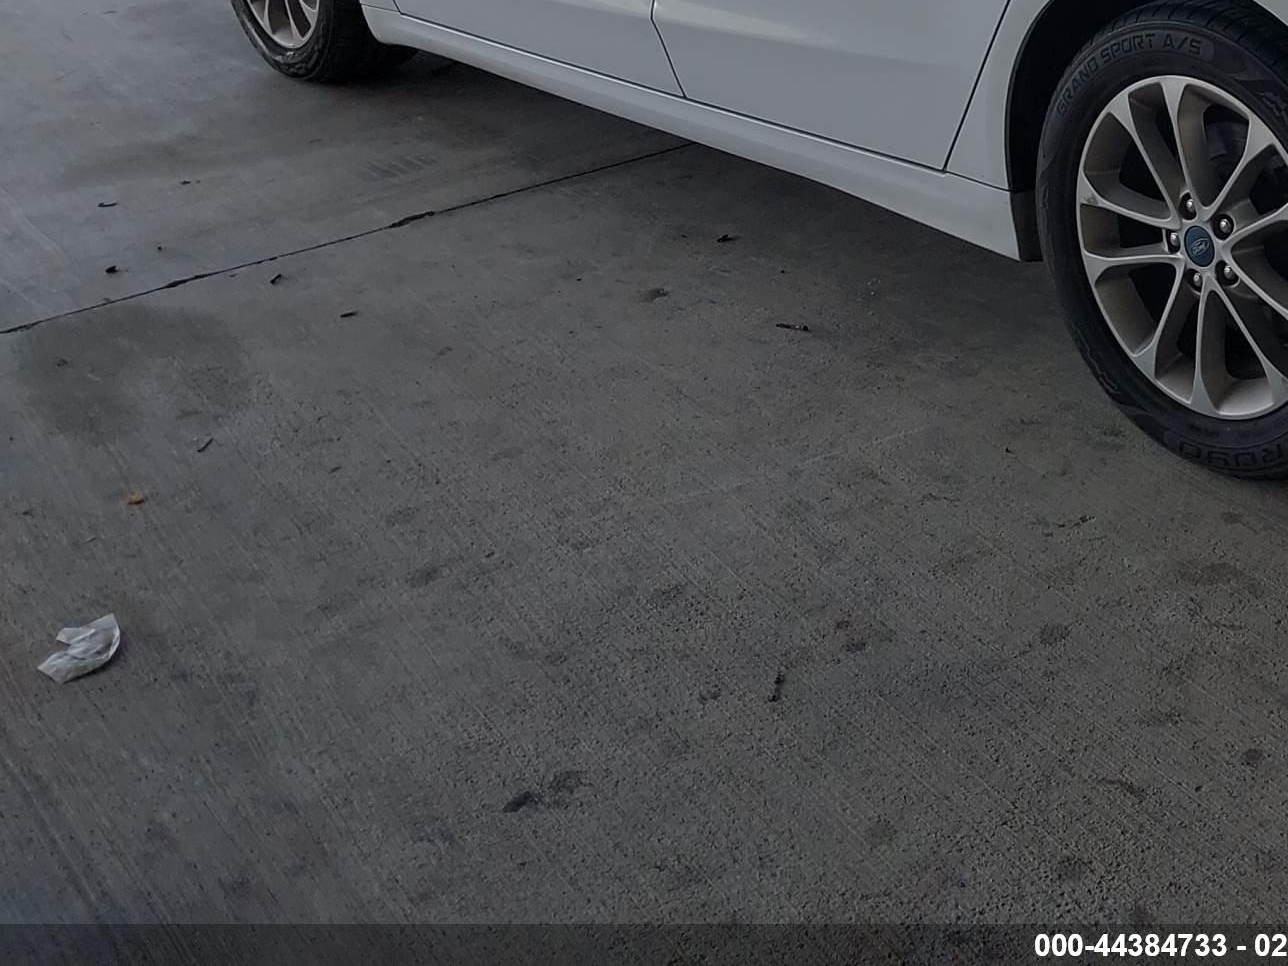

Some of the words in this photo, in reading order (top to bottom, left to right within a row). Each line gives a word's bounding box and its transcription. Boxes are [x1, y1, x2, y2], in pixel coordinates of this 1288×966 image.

[1056, 56, 1099, 115] GRAND
[1101, 34, 1156, 65] SPORT
[1163, 33, 1201, 55] A/S
